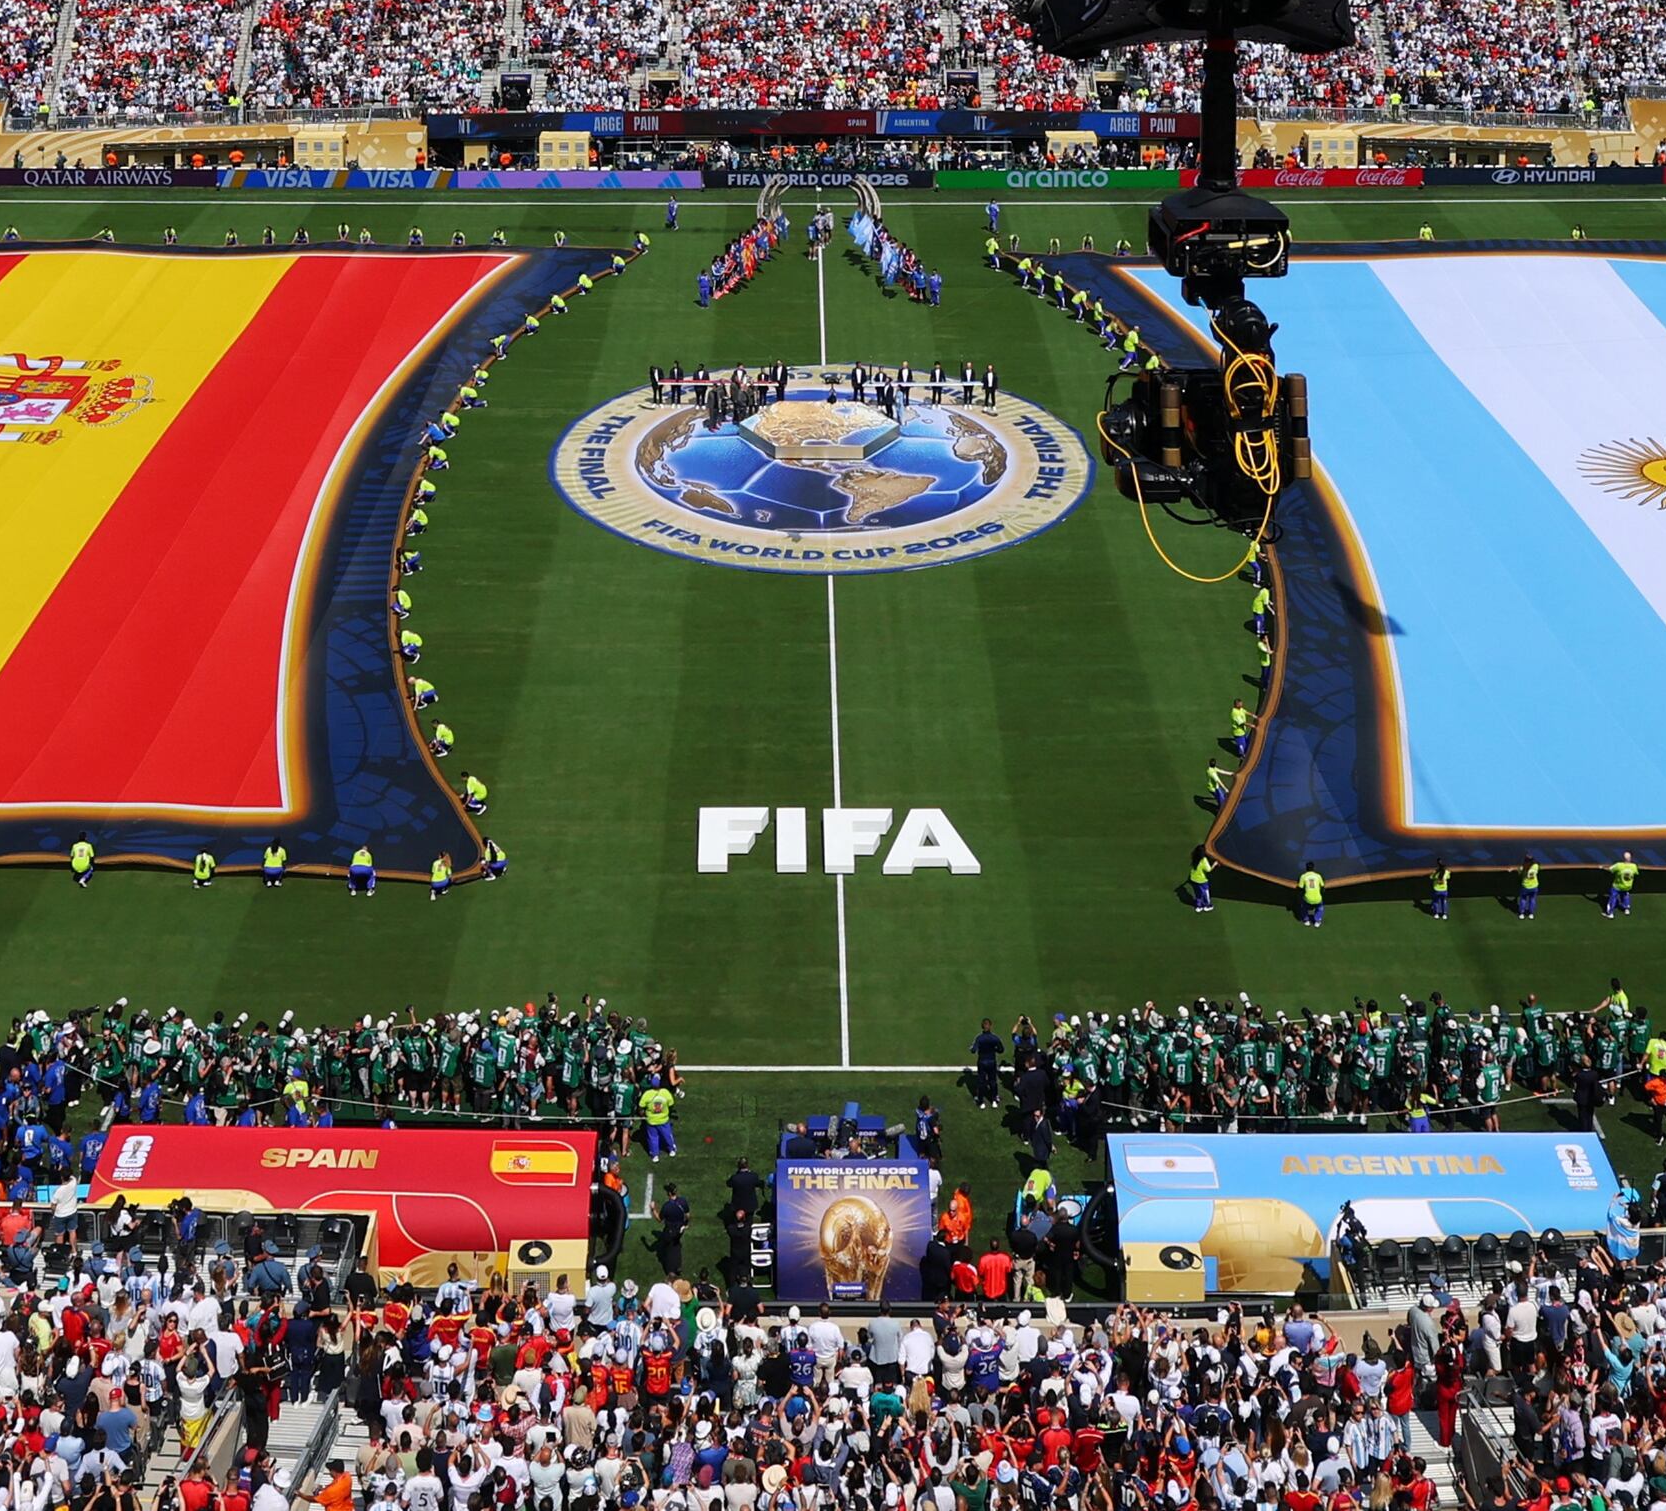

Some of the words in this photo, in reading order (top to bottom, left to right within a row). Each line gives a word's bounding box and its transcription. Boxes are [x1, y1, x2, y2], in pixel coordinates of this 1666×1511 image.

[847, 118, 868, 127] SPAIN
[894, 118, 930, 127] ARGENTINA
[24, 170, 81, 186] QATAR
[86, 169, 173, 186] AIRWAYS
[264, 171, 313, 188] VISA
[367, 171, 415, 188] VISA
[727, 173, 760, 186] FIFA
[763, 173, 826, 186] WORLD
[829, 173, 856, 186] CUP
[1006, 170, 1109, 189] aramco
[1274, 169, 1325, 187] Coca-Cola
[1355, 168, 1406, 186] Coca-Cola
[1524, 170, 1596, 183] HYUNDAI
[597, 414, 636, 445] THE
[1025, 414, 1065, 469] FINAL
[579, 445, 619, 501] FINAL
[1025, 468, 1065, 501] THE
[642, 519, 700, 547] FIFA
[707, 538, 824, 561] WORLD
[832, 546, 893, 561] CUP
[901, 521, 1006, 555] 2026
[697, 806, 982, 876] FIFA
[260, 1147, 380, 1170] SPAIN
[1280, 1154, 1506, 1176] ARGENTINA
[788, 1167, 812, 1175] FIFA
[813, 1167, 854, 1175] WORLD
[855, 1167, 878, 1175] CUP
[879, 1167, 919, 1175] 2026
[788, 1175, 838, 1190] THE
[843, 1175, 919, 1190] FINAL
[793, 1363, 811, 1376] 26
[978, 1360, 997, 1375] 26
[434, 1381, 448, 1395] 10
[418, 1493, 428, 1507] 5
[1121, 1485, 1136, 1507] 10
